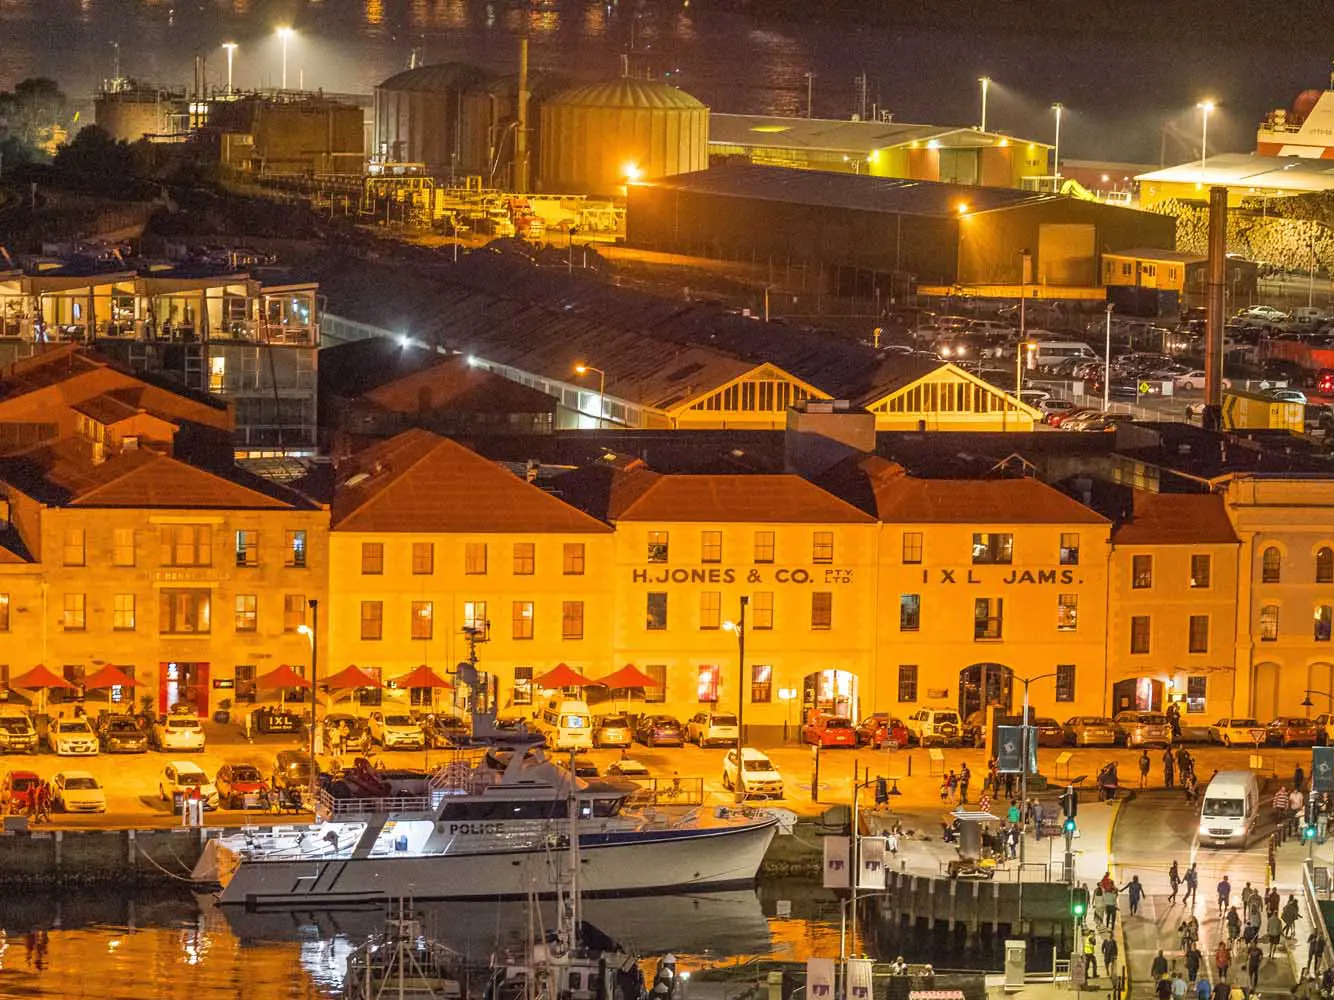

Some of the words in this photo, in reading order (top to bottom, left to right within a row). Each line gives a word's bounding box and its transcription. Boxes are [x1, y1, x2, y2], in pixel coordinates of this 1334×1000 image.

[747, 569, 762, 584] &
[774, 569, 814, 584] CO.
[1003, 570, 1084, 584] JAMS.
[269, 716, 292, 725] IXL
[450, 822, 505, 835] POLICE
